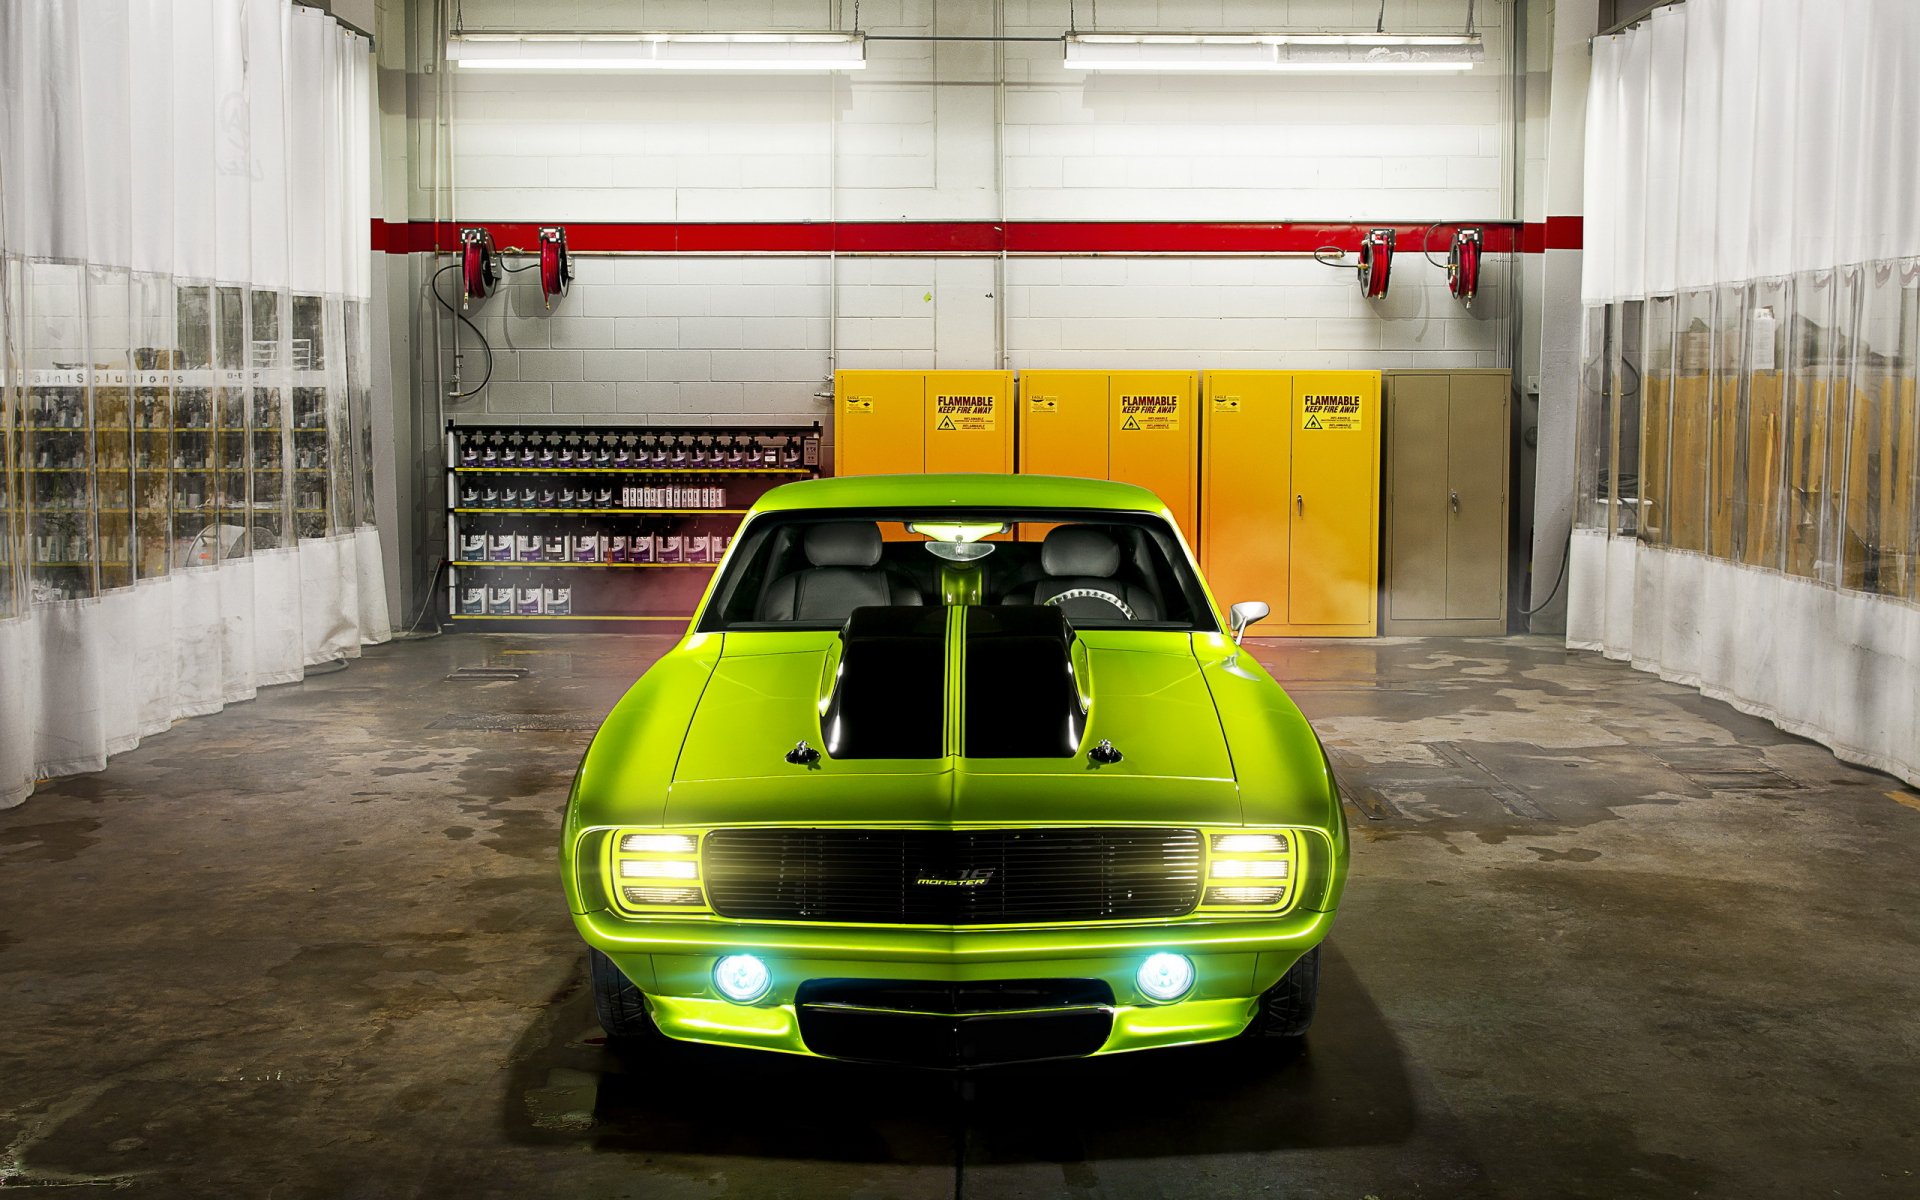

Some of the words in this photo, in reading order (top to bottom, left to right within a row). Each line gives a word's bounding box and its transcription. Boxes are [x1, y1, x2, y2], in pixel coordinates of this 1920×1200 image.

[938, 396, 993, 406] FLAMMABLE
[1122, 396, 1176, 405] FLAMMABLE
[1305, 396, 1359, 405] FLAMMABLE
